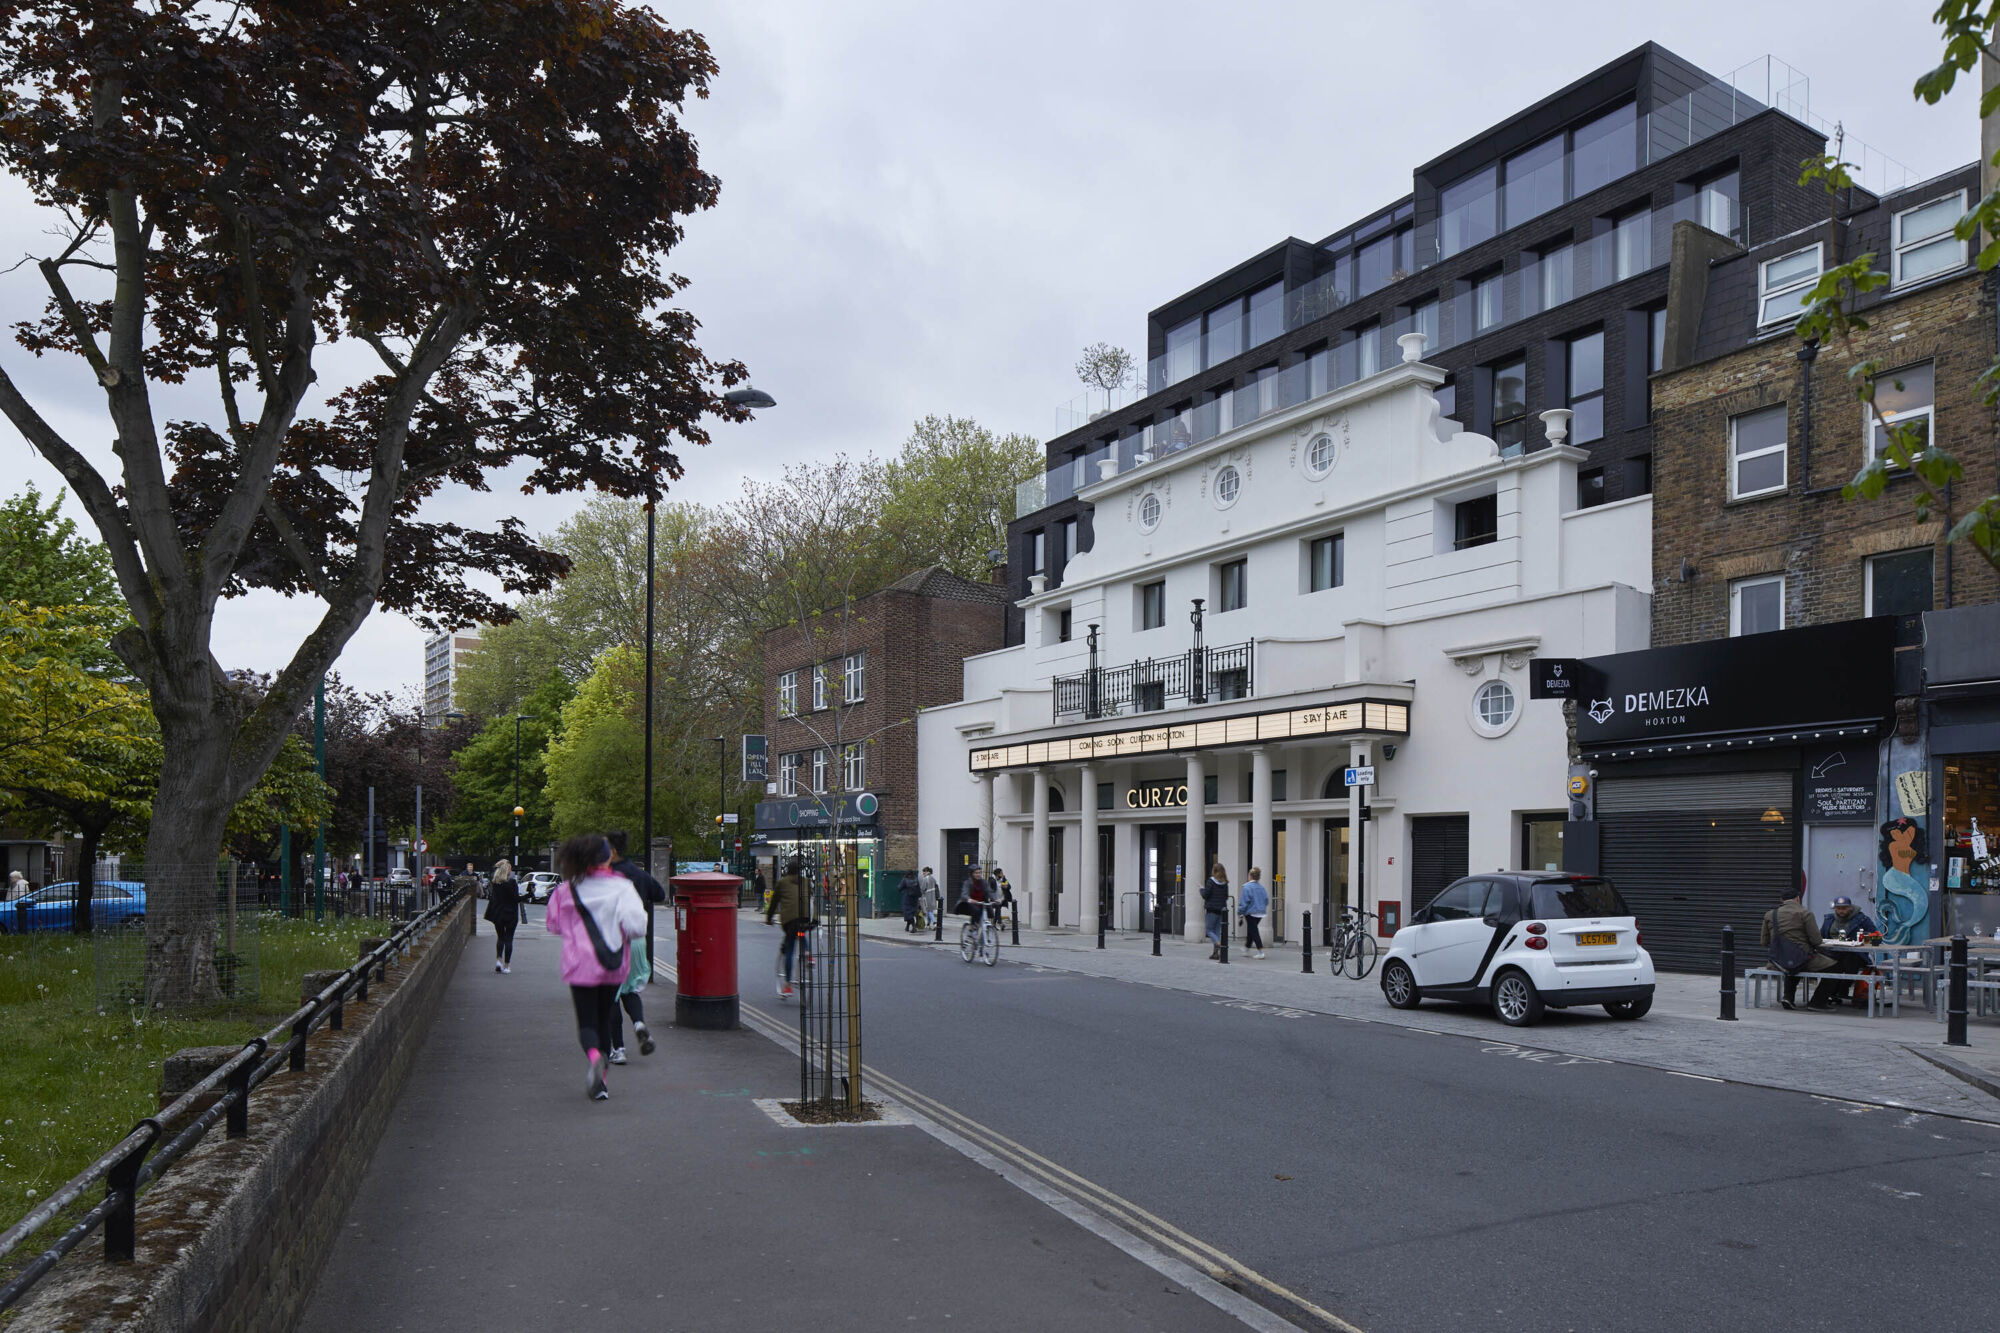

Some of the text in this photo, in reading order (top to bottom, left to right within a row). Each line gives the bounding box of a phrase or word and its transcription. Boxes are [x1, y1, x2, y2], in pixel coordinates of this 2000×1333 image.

[1546, 679, 1571, 688] DEMEZKA
[1625, 686, 1709, 713] DEMEZKA
[1303, 710, 1347, 724] STAY SAFE
[1645, 715, 1686, 726] HOXTON
[1079, 730, 1185, 750] COMNG SOON CURZON HOXTON
[1126, 785, 1188, 809] CURZO
[1581, 934, 1601, 945] LC57
